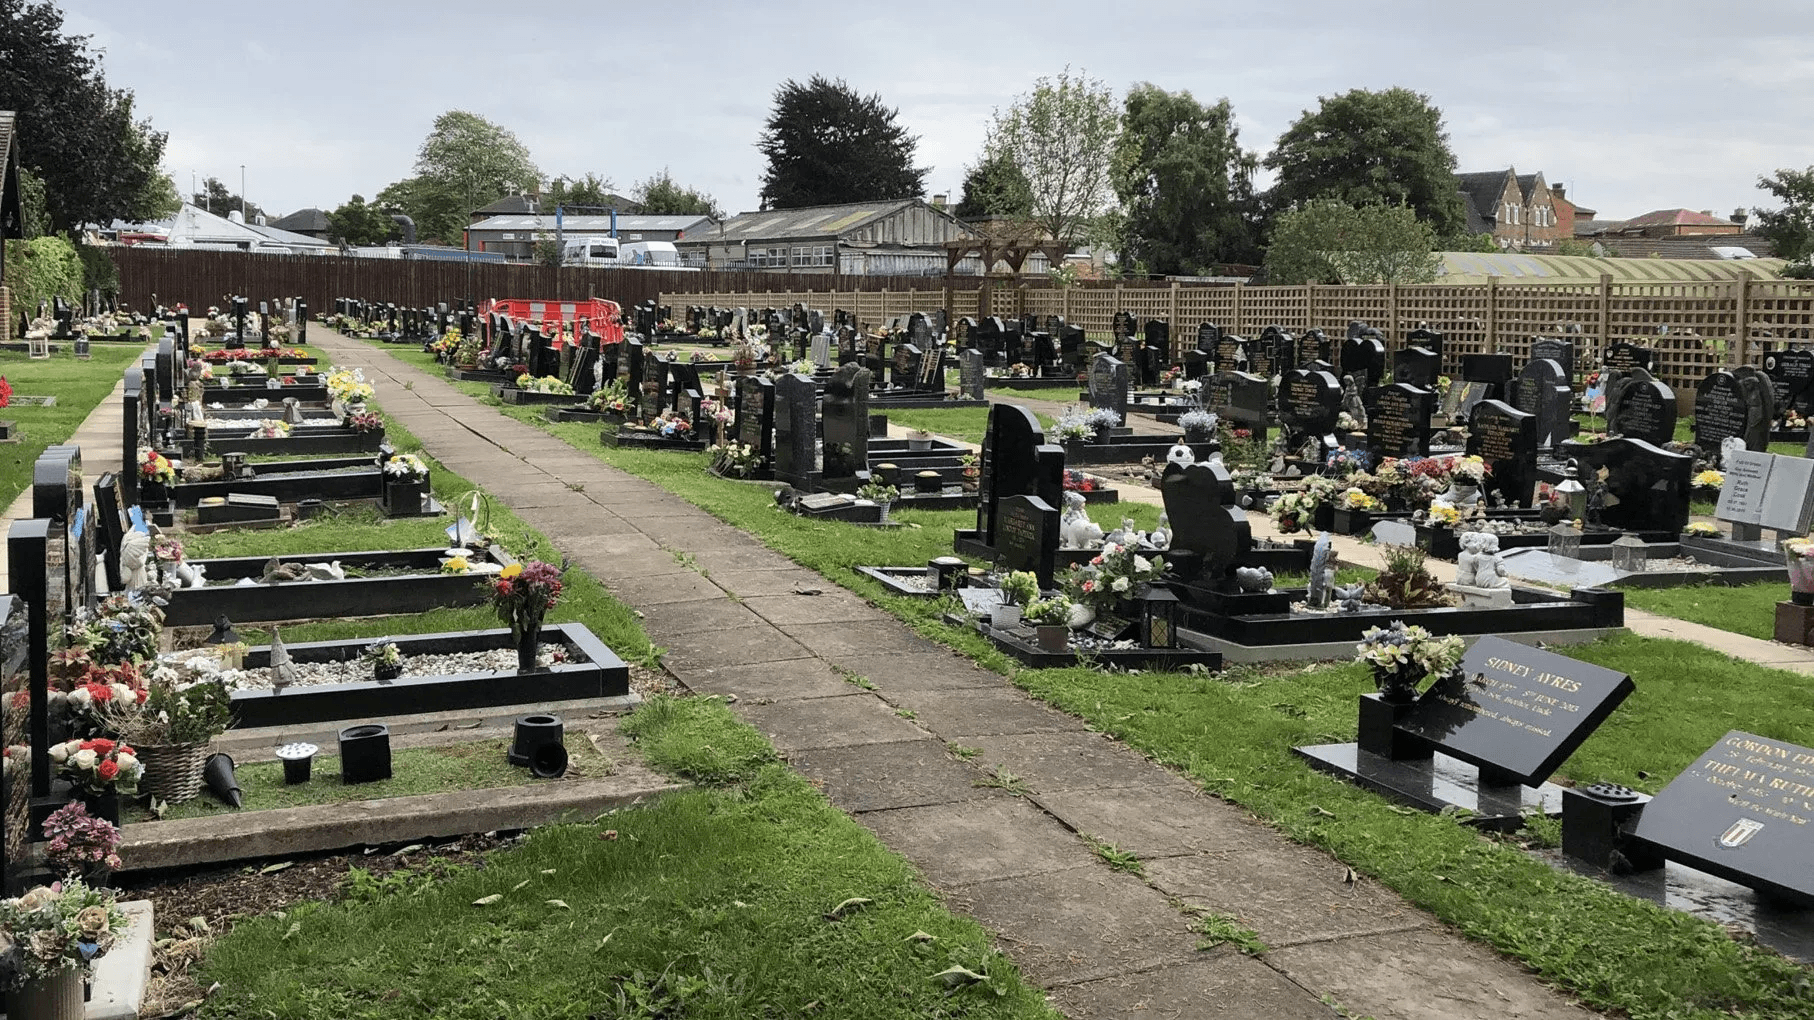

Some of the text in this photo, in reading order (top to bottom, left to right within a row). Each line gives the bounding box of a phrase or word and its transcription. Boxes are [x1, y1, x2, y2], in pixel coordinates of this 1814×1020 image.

[1484, 657, 1533, 678] SIDNEY
[1533, 672, 1582, 693] AYRES
[1534, 692, 1559, 706] JUNE
[1726, 737, 1791, 759] GORDON
[1704, 760, 1766, 784] THELMA
